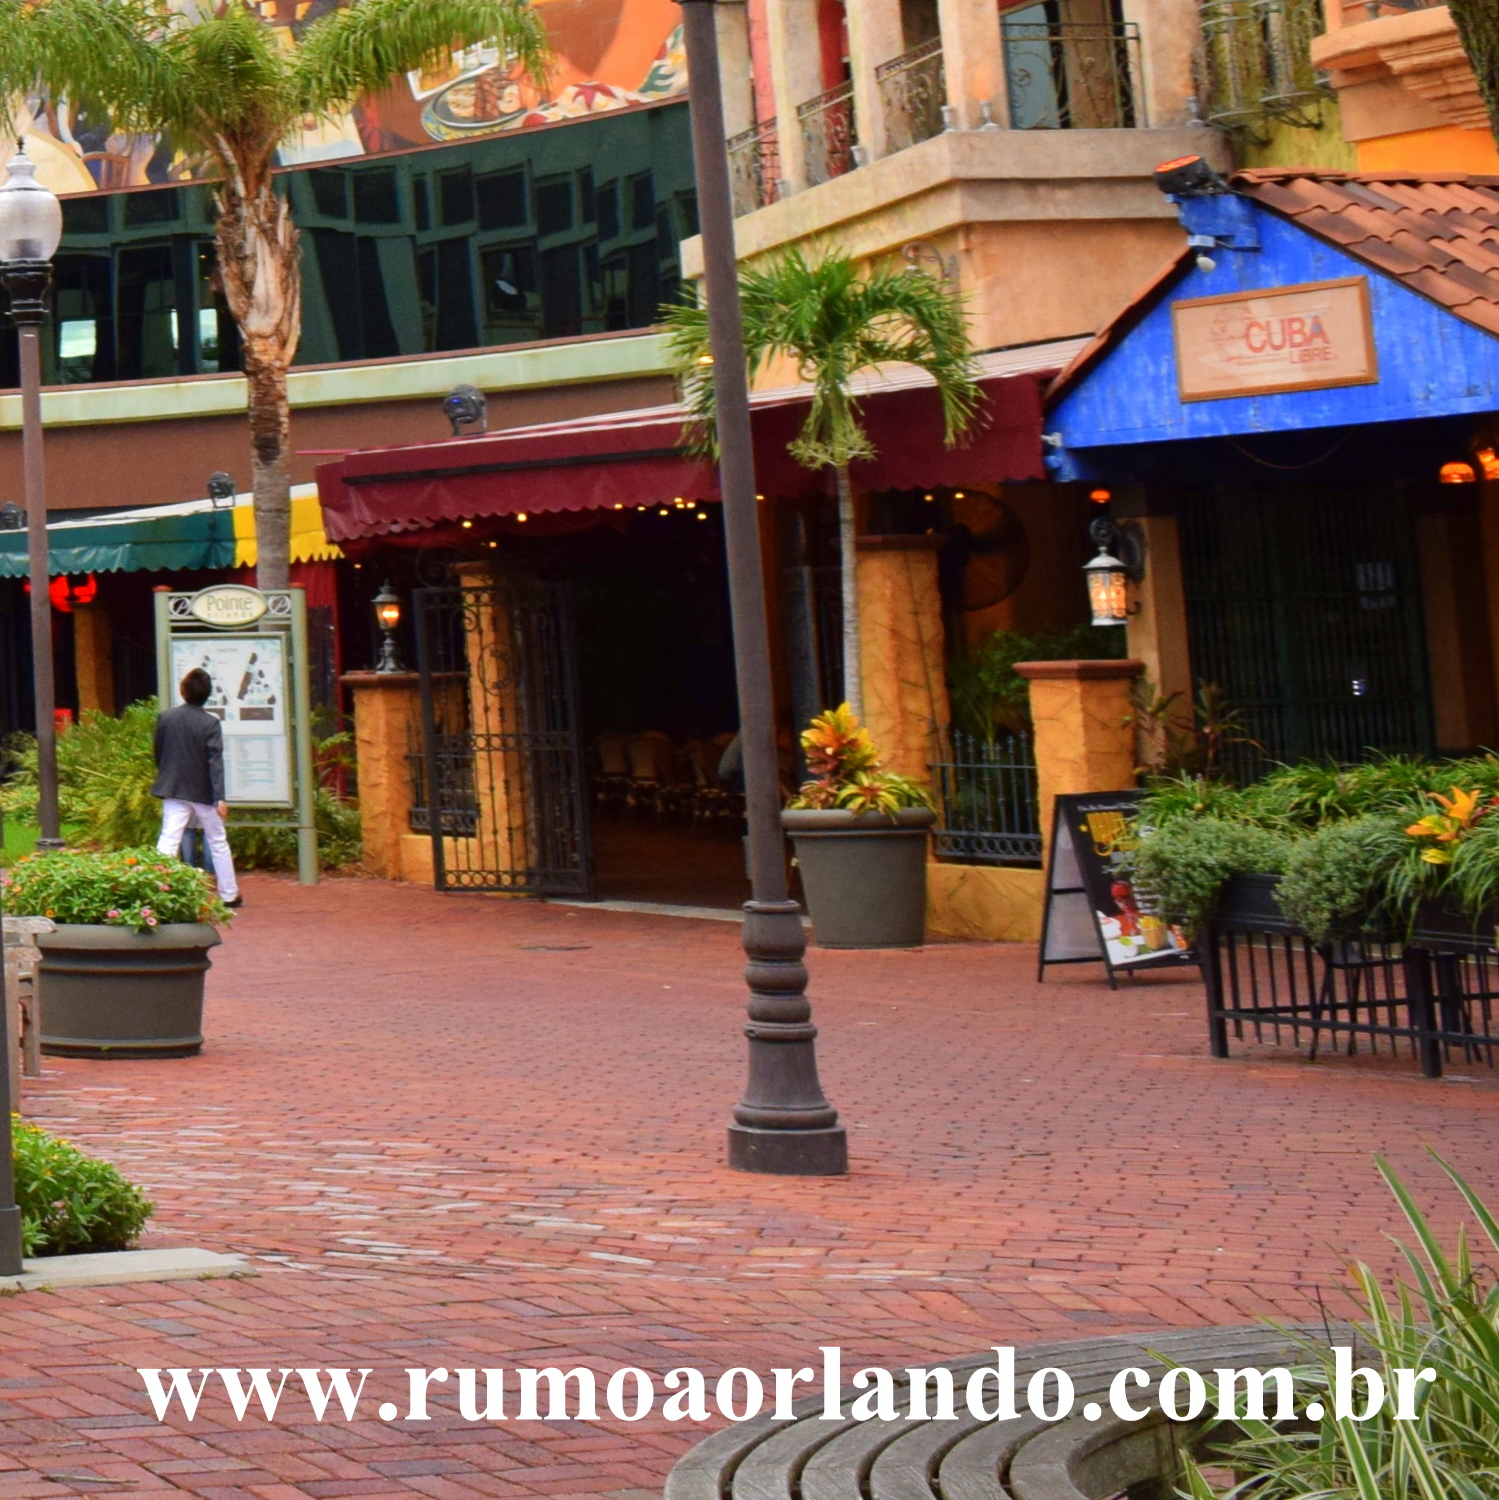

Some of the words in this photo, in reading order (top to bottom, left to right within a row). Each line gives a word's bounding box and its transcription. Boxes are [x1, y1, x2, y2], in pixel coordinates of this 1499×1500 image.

[1244, 315, 1331, 353] CUBA
[1289, 347, 1333, 365] LIBRE
[206, 595, 253, 611] Pointe
